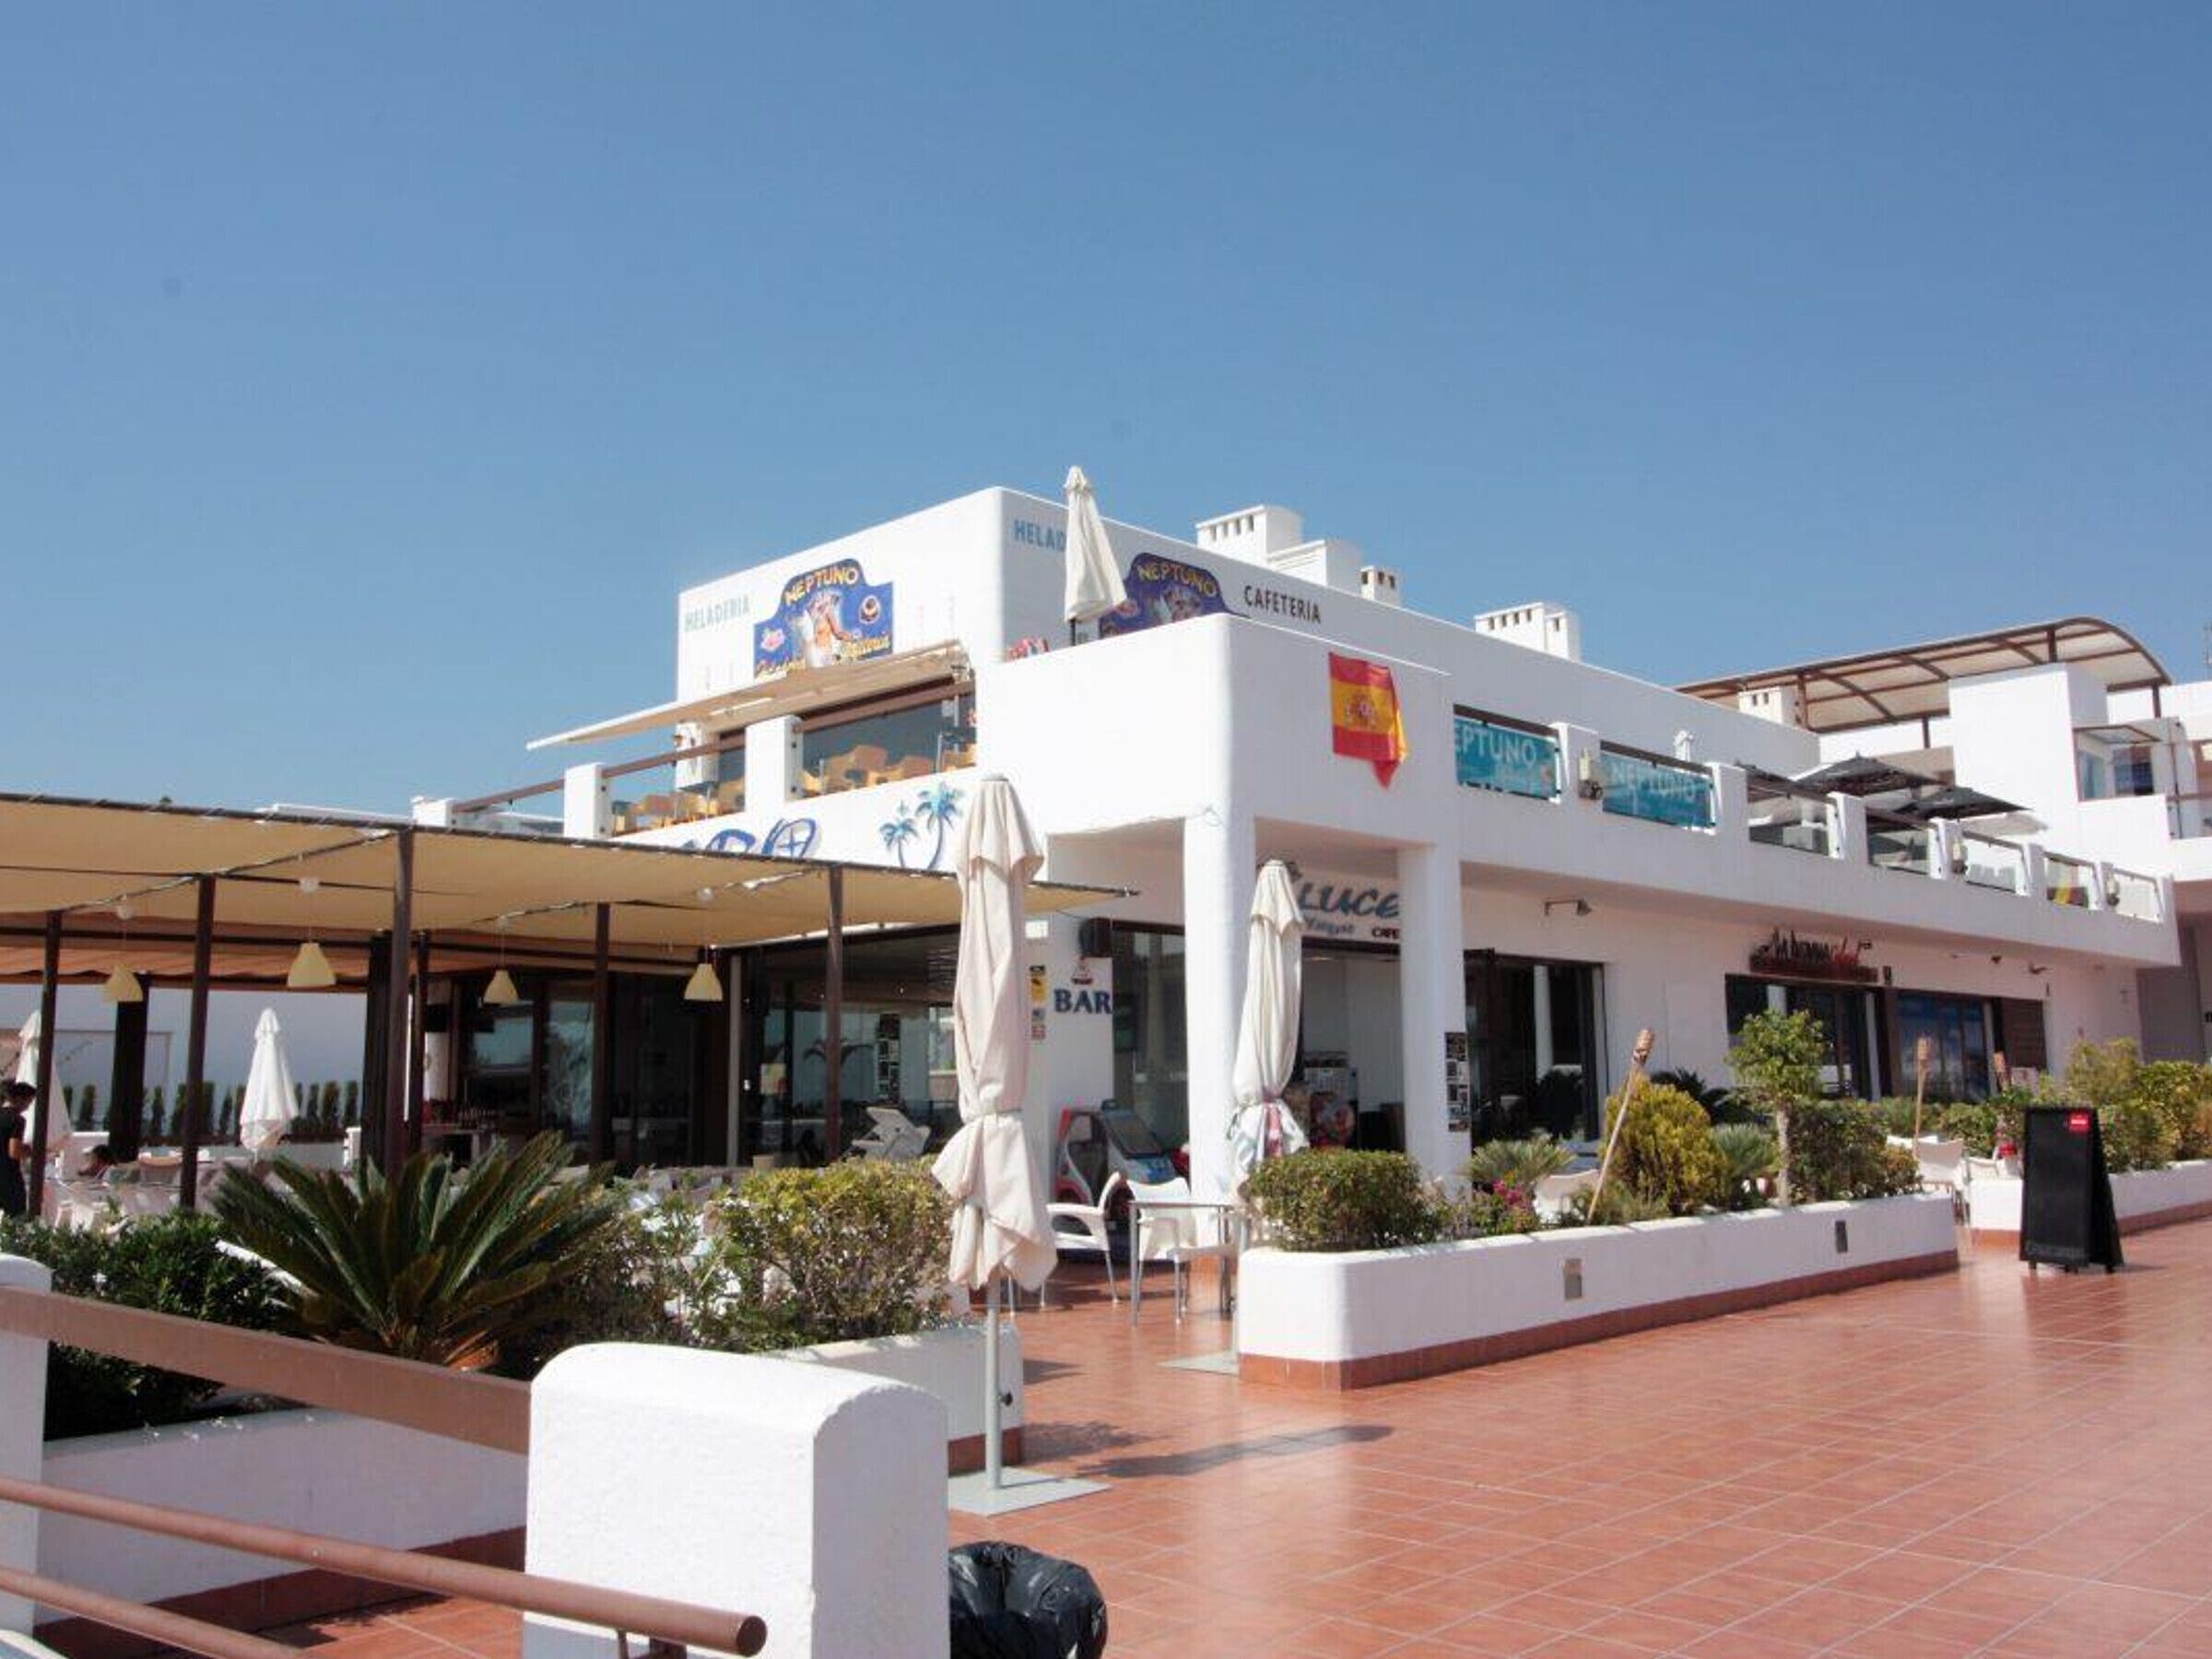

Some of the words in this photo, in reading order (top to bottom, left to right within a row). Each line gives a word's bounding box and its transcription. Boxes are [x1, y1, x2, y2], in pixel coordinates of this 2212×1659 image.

[784, 566, 860, 606] NEPTUNO
[1135, 560, 1218, 598] NEPTUNO
[683, 595, 750, 632] HELADERIA
[1244, 584, 1322, 624] CAFETERIA
[1053, 989, 1113, 1014] BAR
